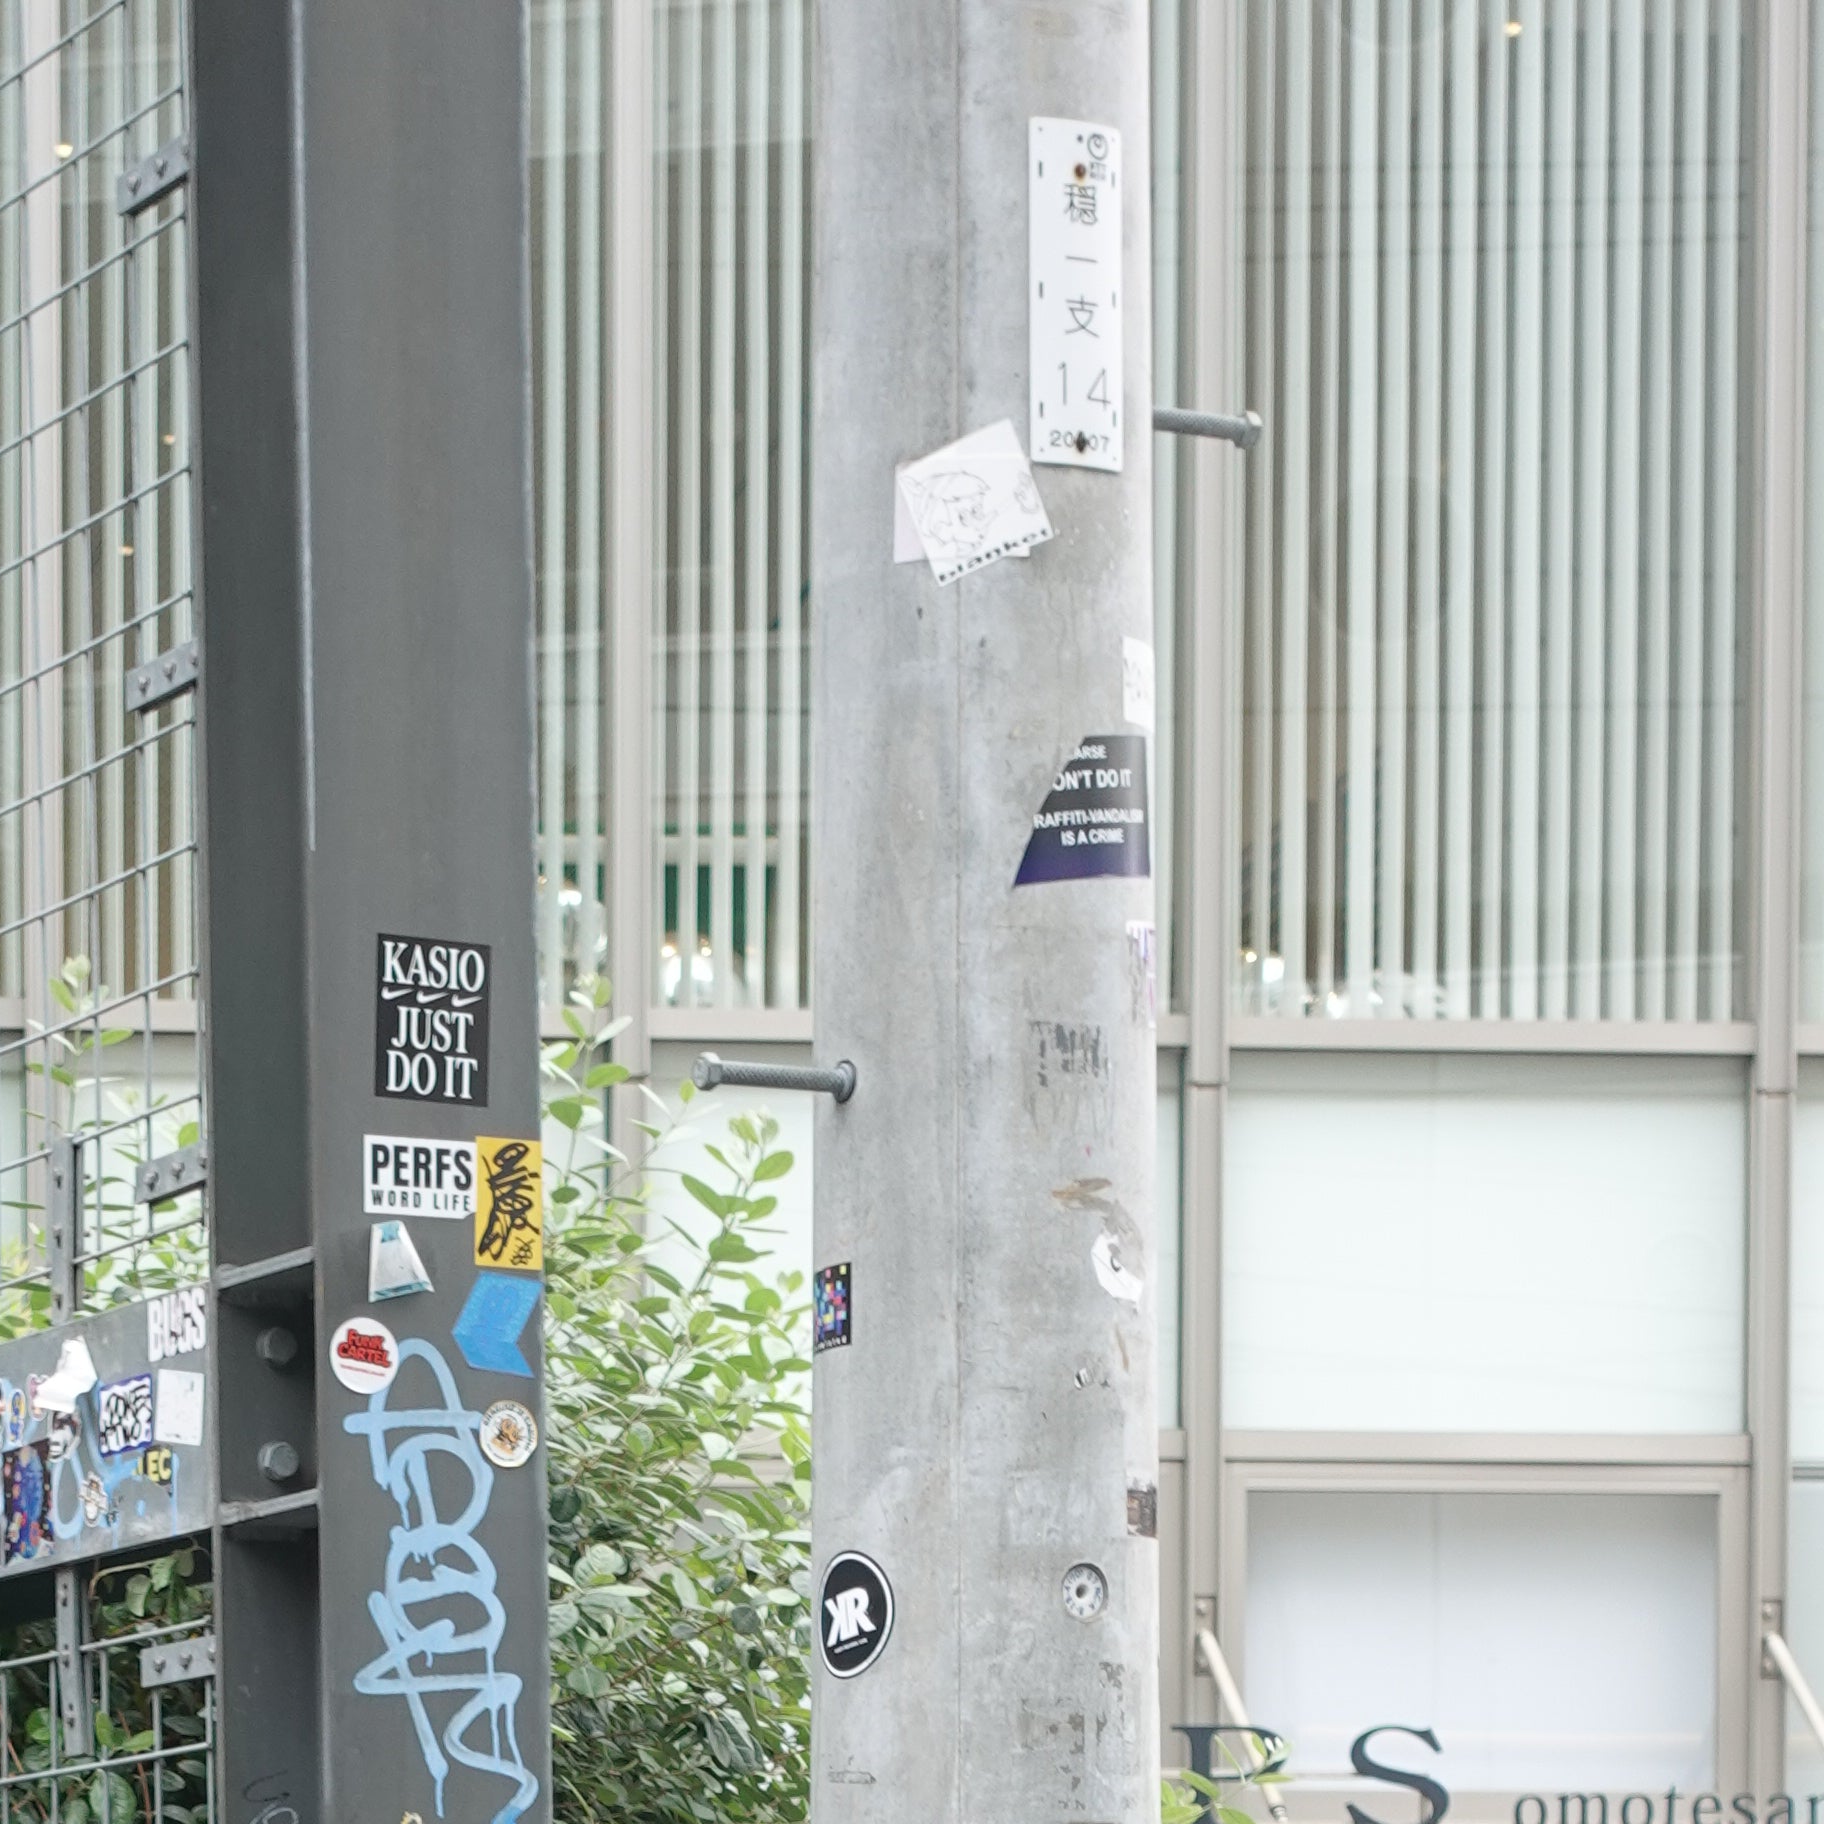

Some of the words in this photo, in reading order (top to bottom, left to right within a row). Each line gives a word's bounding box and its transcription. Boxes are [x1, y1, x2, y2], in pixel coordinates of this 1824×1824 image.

[1057, 361, 1112, 411] 14
[1095, 768, 1120, 789] DO
[1119, 767, 1133, 788] IT
[382, 940, 486, 993] KASIO
[390, 1005, 475, 1054] JUST
[385, 1049, 437, 1096] DO
[443, 1055, 479, 1100] IT
[371, 1143, 473, 1191] PERFS
[371, 1189, 422, 1208] WORD
[433, 1193, 471, 1213] LIFE
[337, 1341, 392, 1369] CARTEL
[346, 1328, 385, 1351] FUNK
